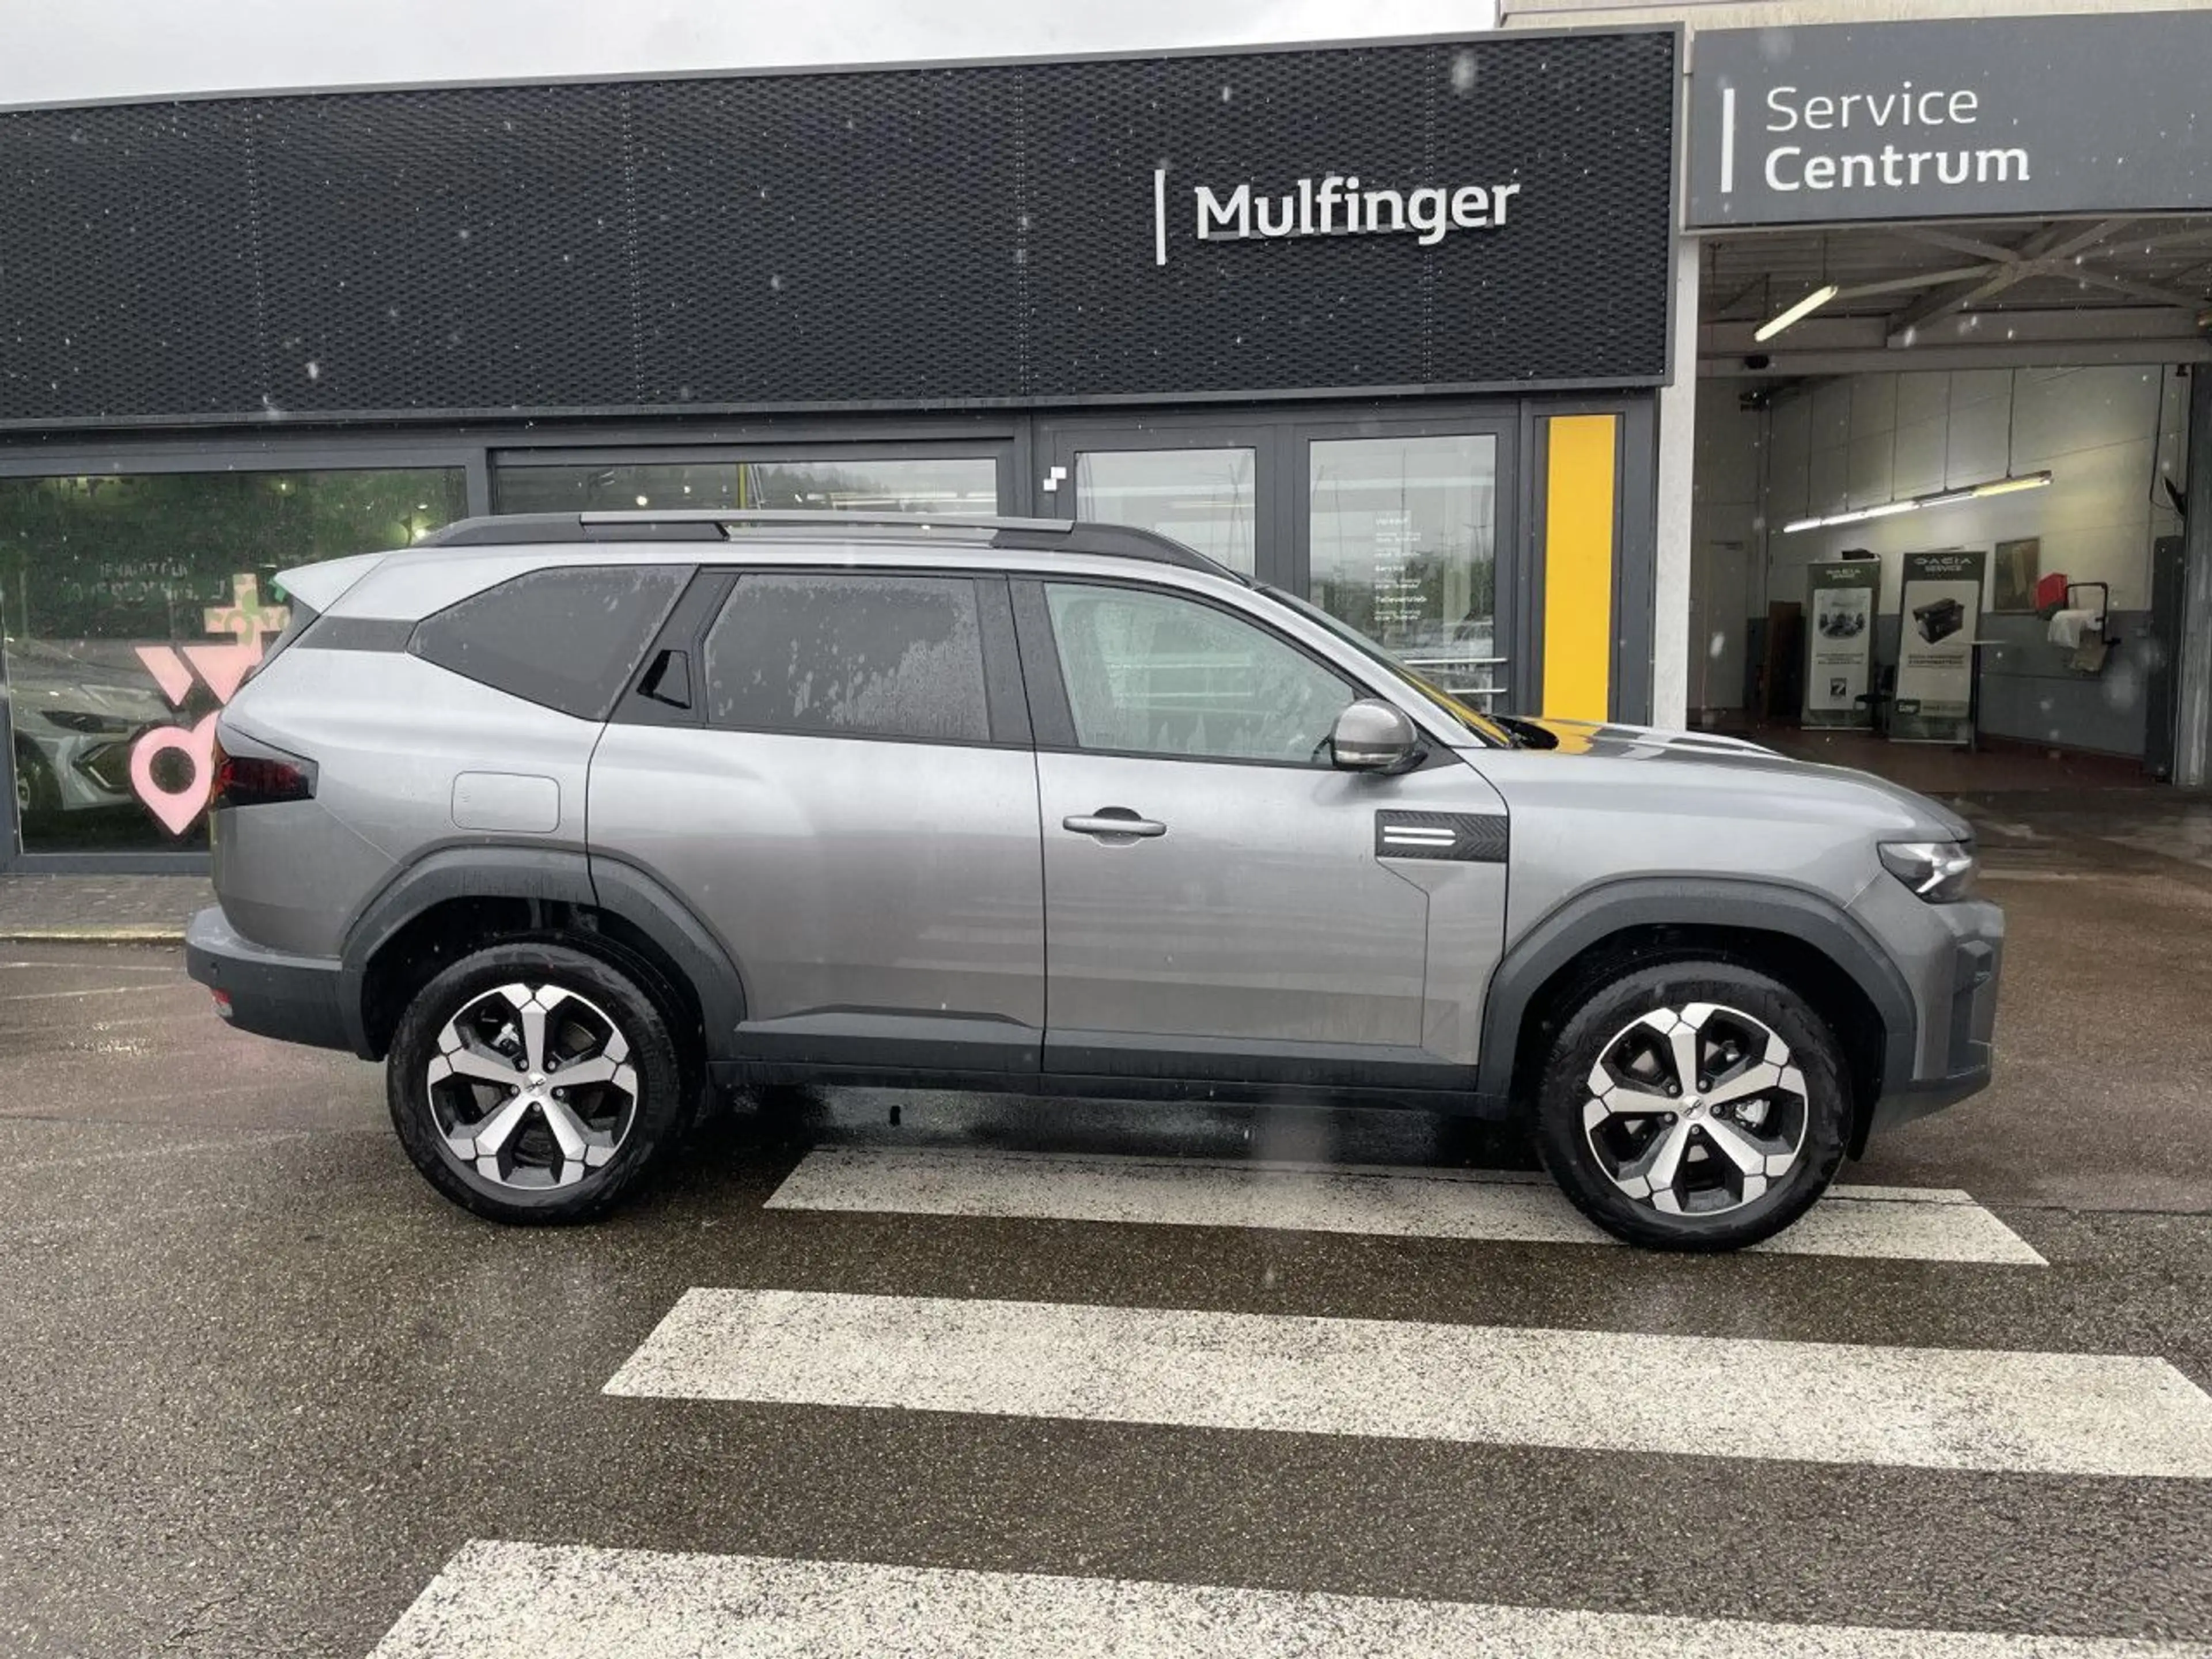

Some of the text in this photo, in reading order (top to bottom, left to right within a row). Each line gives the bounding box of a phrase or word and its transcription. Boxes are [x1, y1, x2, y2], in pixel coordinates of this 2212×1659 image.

[1766, 81, 1978, 131] Service
[1765, 145, 2030, 191] Centrum
[1194, 176, 1520, 245] Mulfinger
[1914, 556, 1972, 565] DACIA
